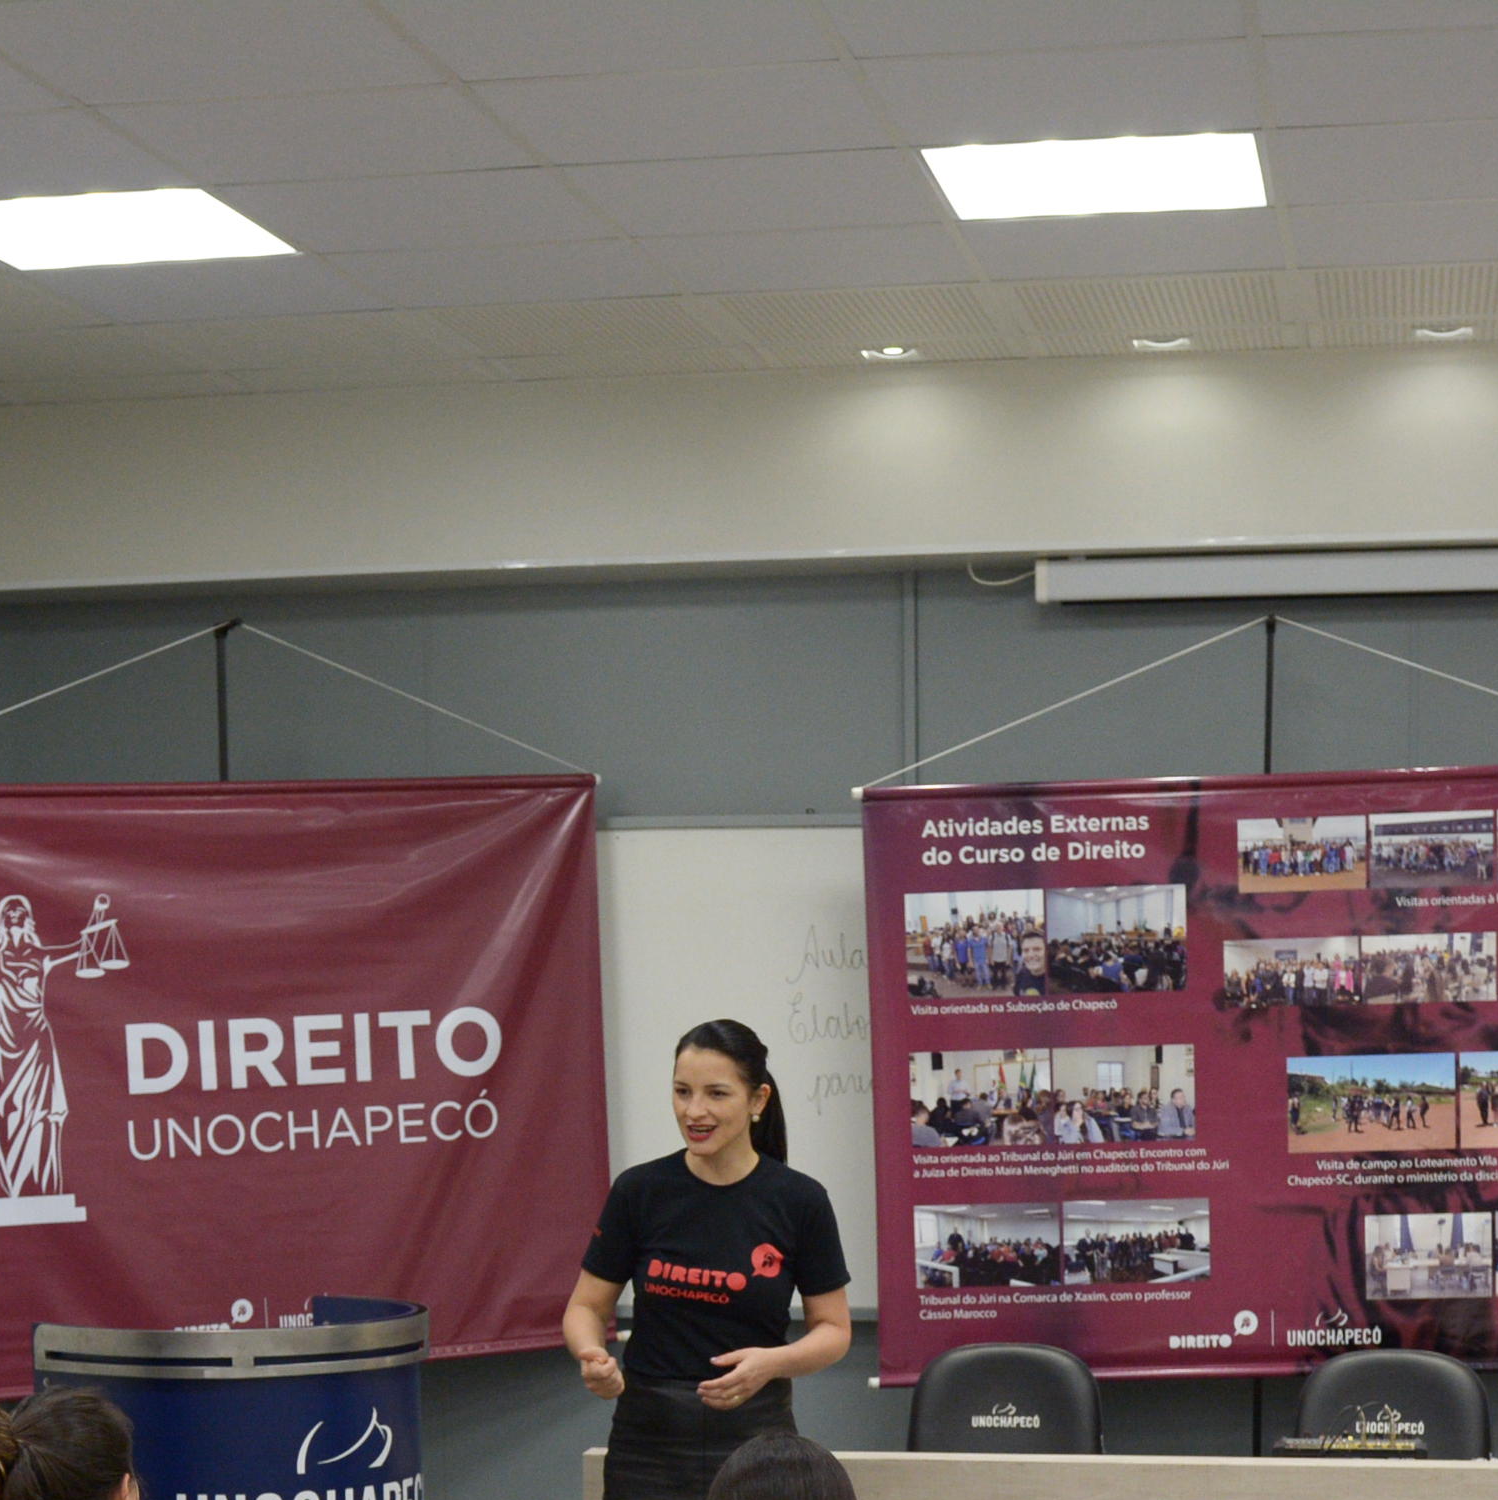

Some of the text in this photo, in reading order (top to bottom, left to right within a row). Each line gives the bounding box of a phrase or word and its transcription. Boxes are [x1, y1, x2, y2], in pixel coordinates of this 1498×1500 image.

[921, 814, 1149, 839] Atividades Externas
[922, 840, 1146, 866] do Curso de Direito
[1395, 894, 1430, 907] Visitas
[1430, 892, 1487, 906] orientadas
[911, 997, 1118, 1015] Visita orientada na Subseção de Chapecó
[124, 1007, 502, 1095] DIREITO
[127, 1090, 500, 1162] UNOCHAPECÓ
[912, 1153, 939, 1164] Visita
[939, 1151, 987, 1164] orientada
[1001, 1150, 1041, 1162] Tribunal
[1056, 1149, 1075, 1160] Júri
[1092, 1147, 1138, 1162] Chapecó:
[1139, 1146, 1184, 1158] Encontro
[1184, 1147, 1207, 1157] com
[1315, 1158, 1345, 1171] Visita
[1361, 1159, 1399, 1172] campo
[1413, 1155, 1477, 1168] Loteamento
[1477, 1154, 1498, 1166] Vila
[961, 1165, 994, 1177] Direito
[1095, 1161, 1140, 1173] auditório
[1156, 1159, 1195, 1171] Tribunal
[1212, 1158, 1230, 1170] Júri
[1286, 1172, 1353, 1189] Chapecó-SC,
[1353, 1171, 1396, 1184] durante
[1405, 1170, 1459, 1183] ministério
[647, 1259, 747, 1291] DIREITO
[919, 1293, 961, 1305] Tribunal
[978, 1292, 997, 1304] Júri
[1012, 1291, 1058, 1303] Comarca
[1074, 1290, 1109, 1305] Xaxim,
[1110, 1291, 1133, 1301] com
[1143, 1288, 1191, 1303] professor
[918, 1306, 998, 1320] Cássio Marocco
[1169, 1334, 1232, 1350] DIREITO
